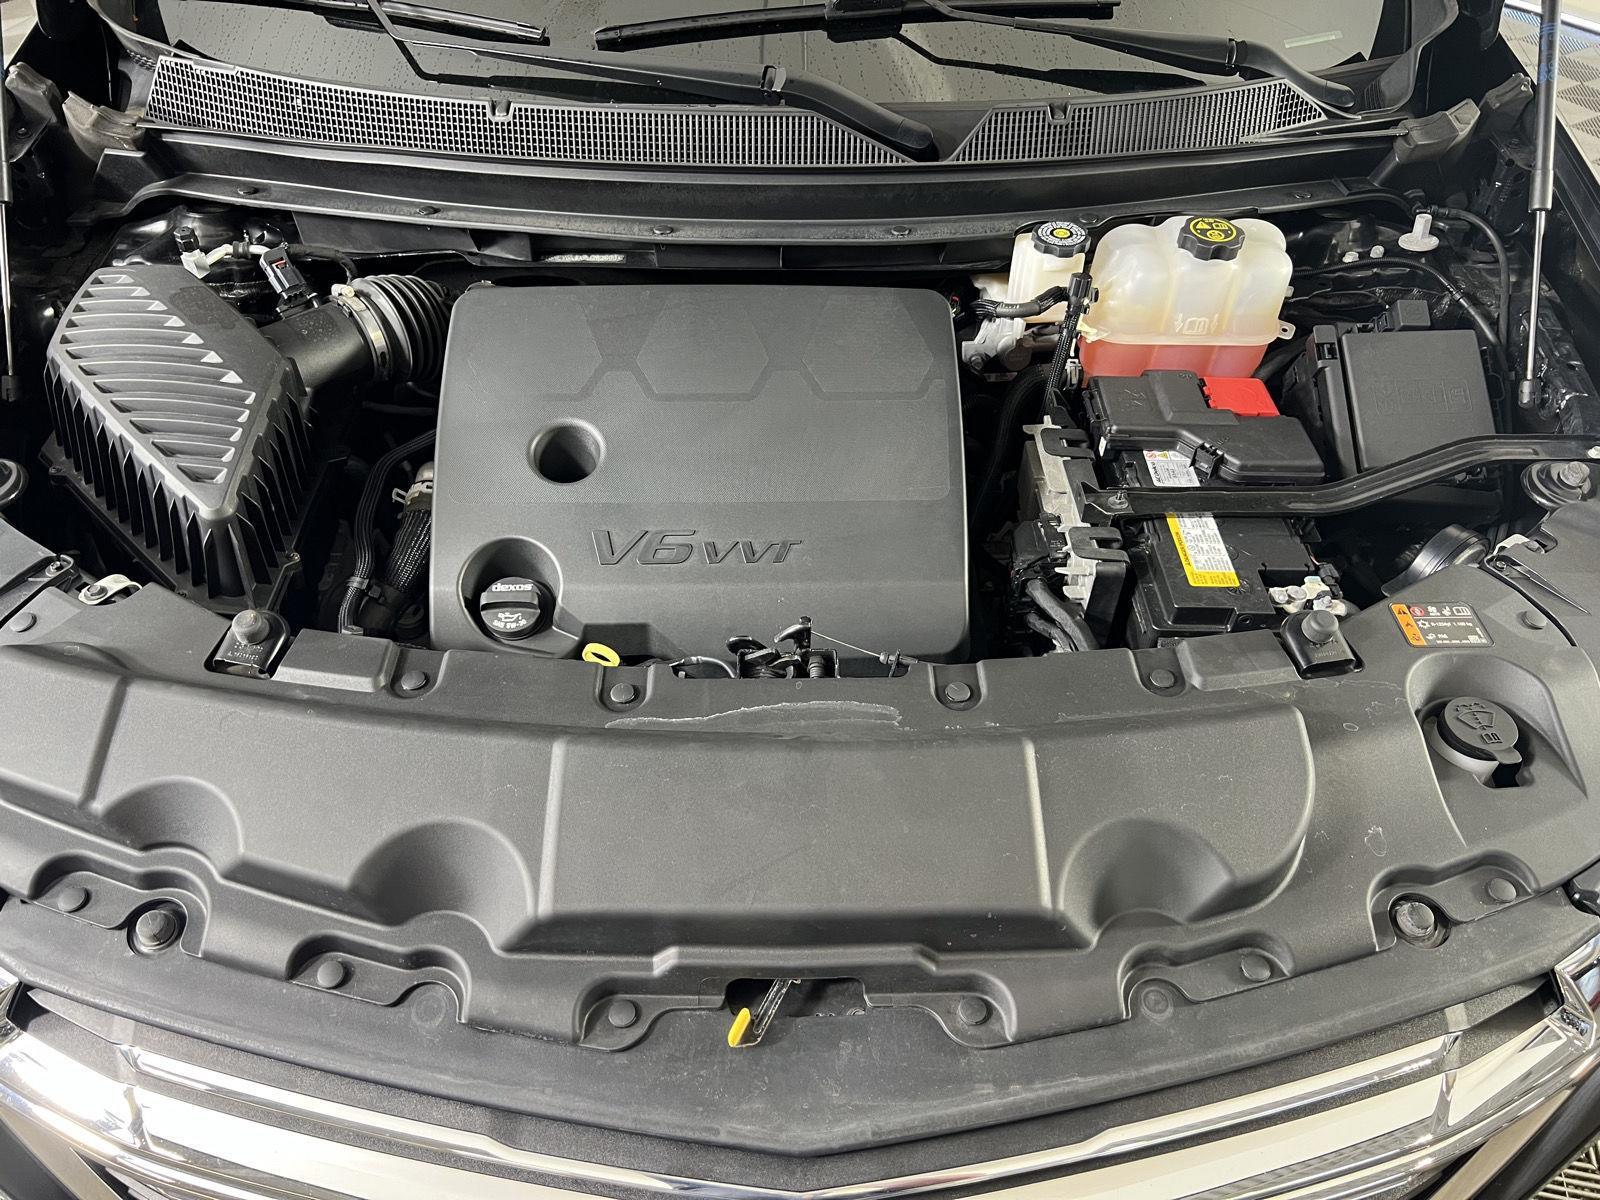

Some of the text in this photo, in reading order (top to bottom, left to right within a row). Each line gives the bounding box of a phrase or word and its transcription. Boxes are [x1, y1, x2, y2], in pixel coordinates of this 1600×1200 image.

[592, 529, 802, 566] V6 VVT
[492, 582, 534, 592] dexos
[492, 619, 506, 629] SAE
